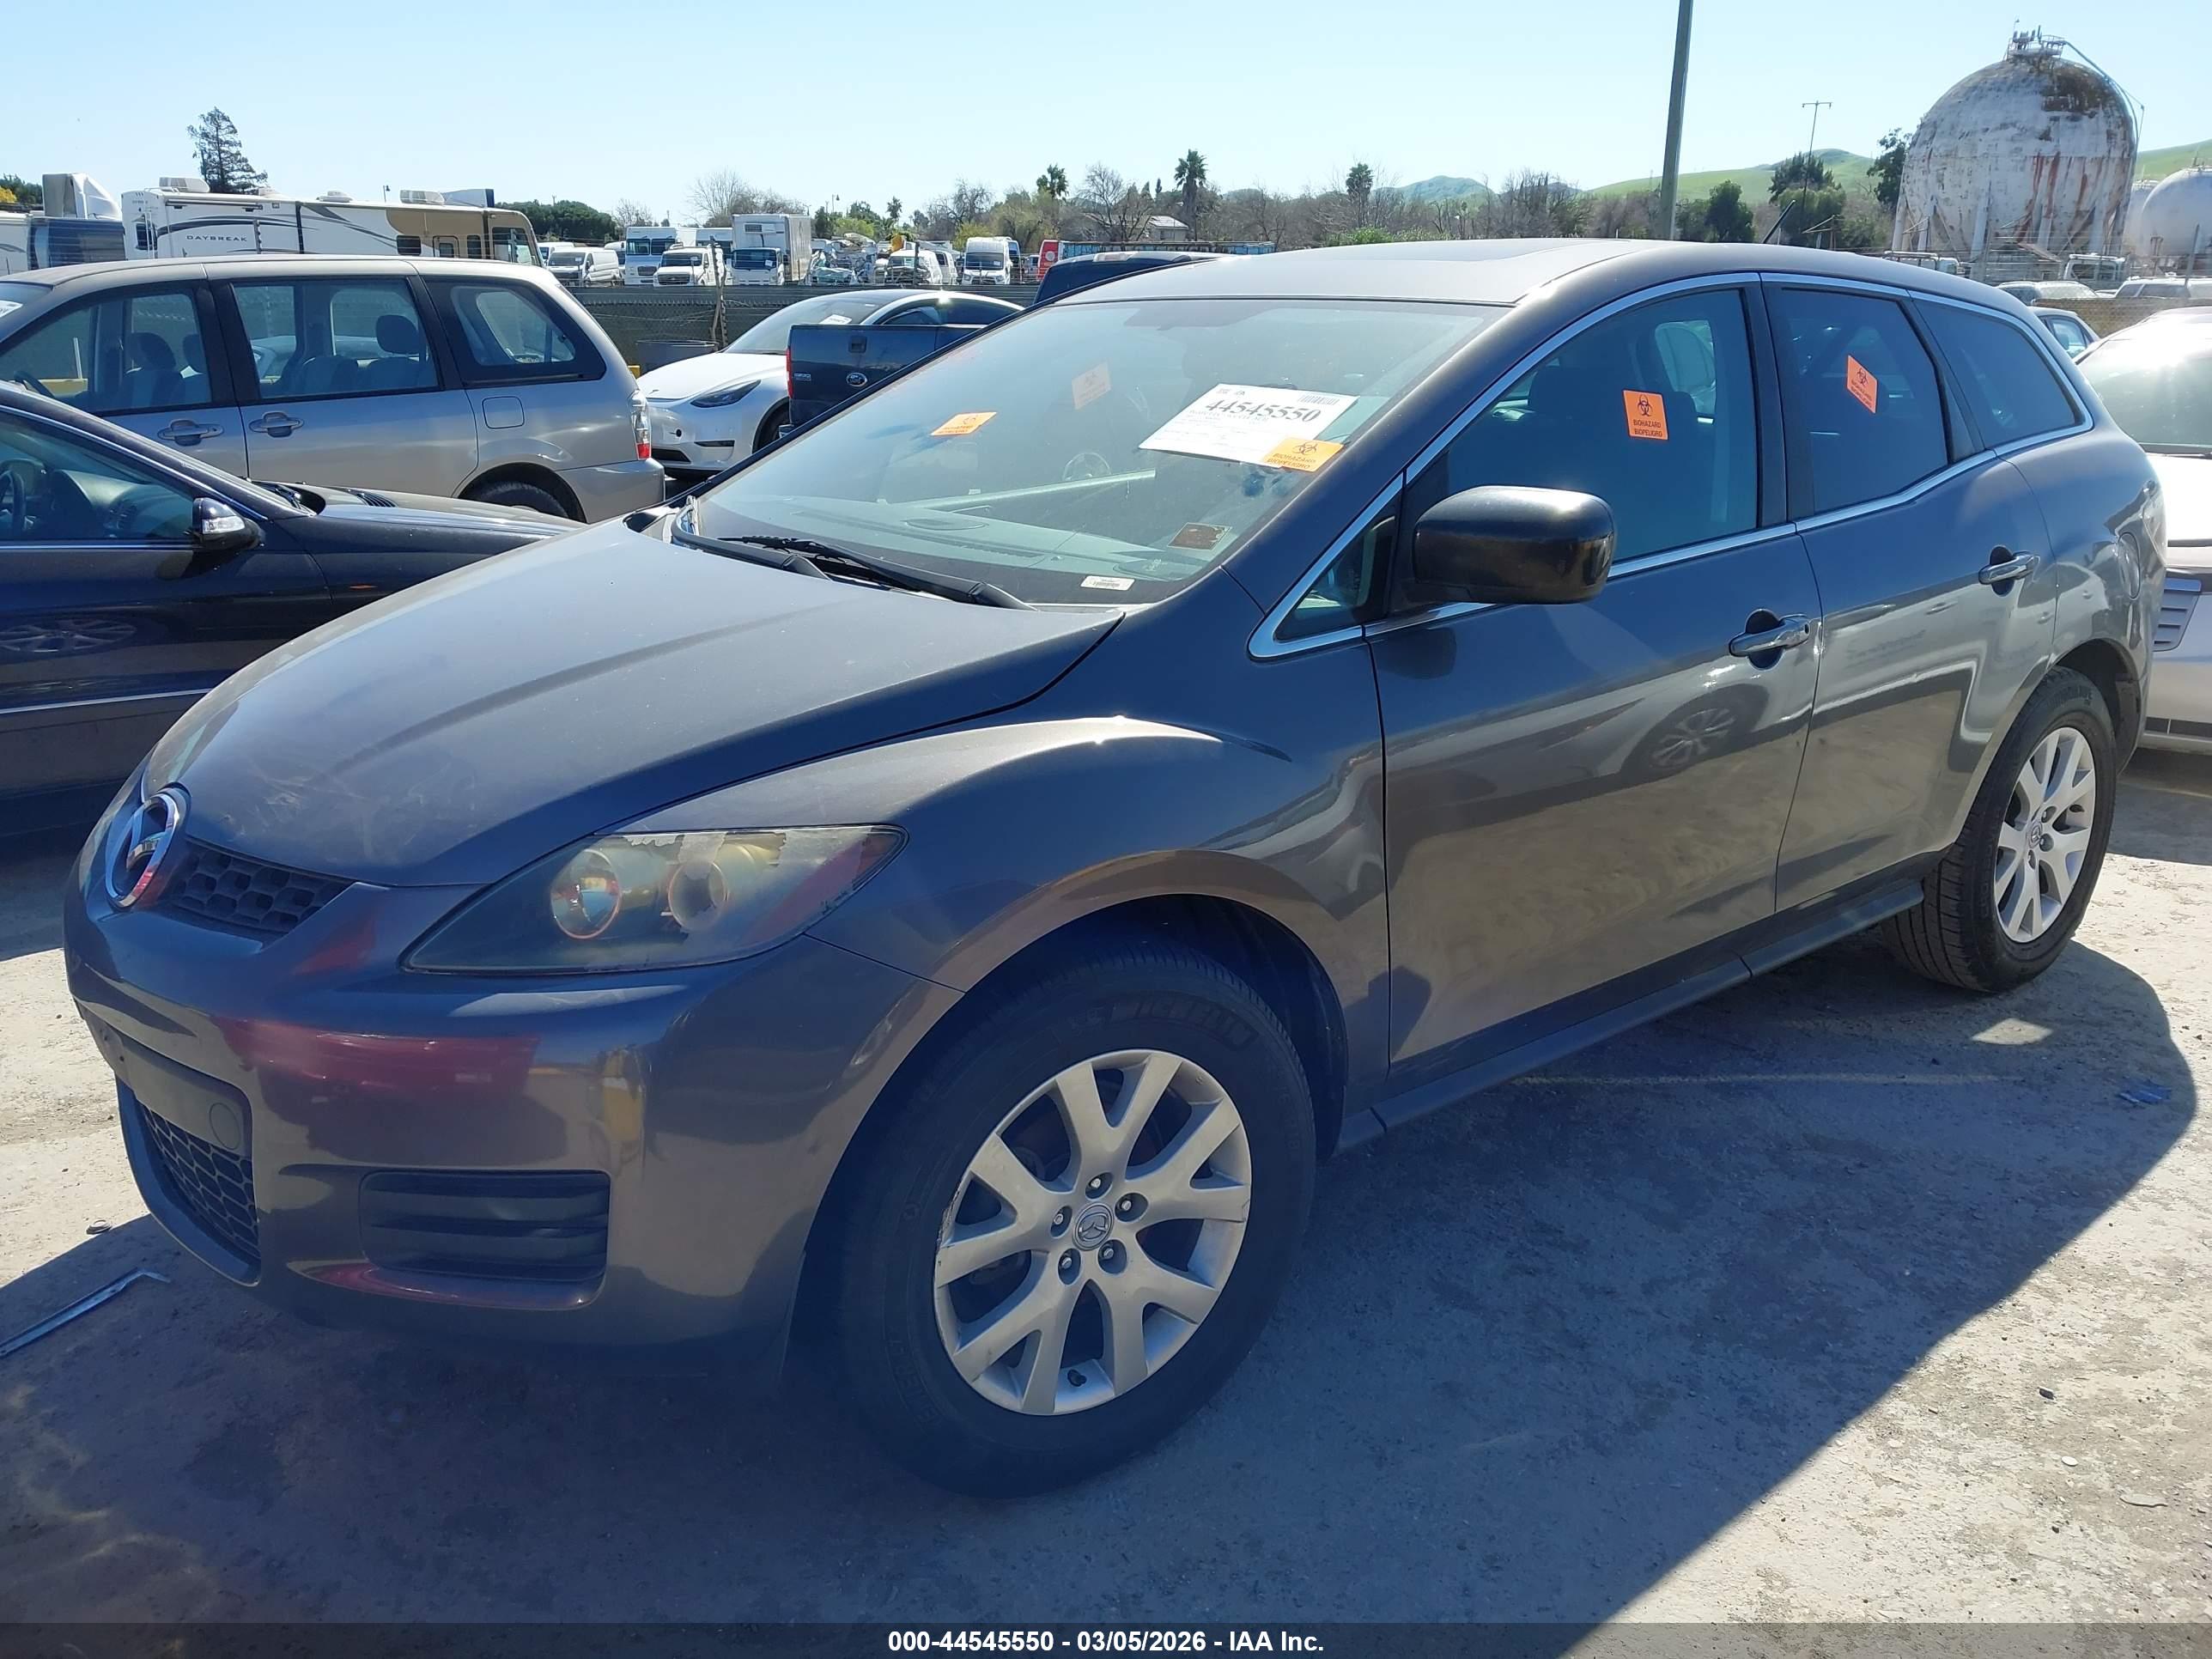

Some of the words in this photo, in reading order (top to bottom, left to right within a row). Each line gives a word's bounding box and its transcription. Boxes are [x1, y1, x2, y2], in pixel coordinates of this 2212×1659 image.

[1205, 399, 1321, 422] 44545550
[1632, 419, 1662, 428] BIOHAZARD
[1272, 453, 1317, 464] BIOHAZARD
